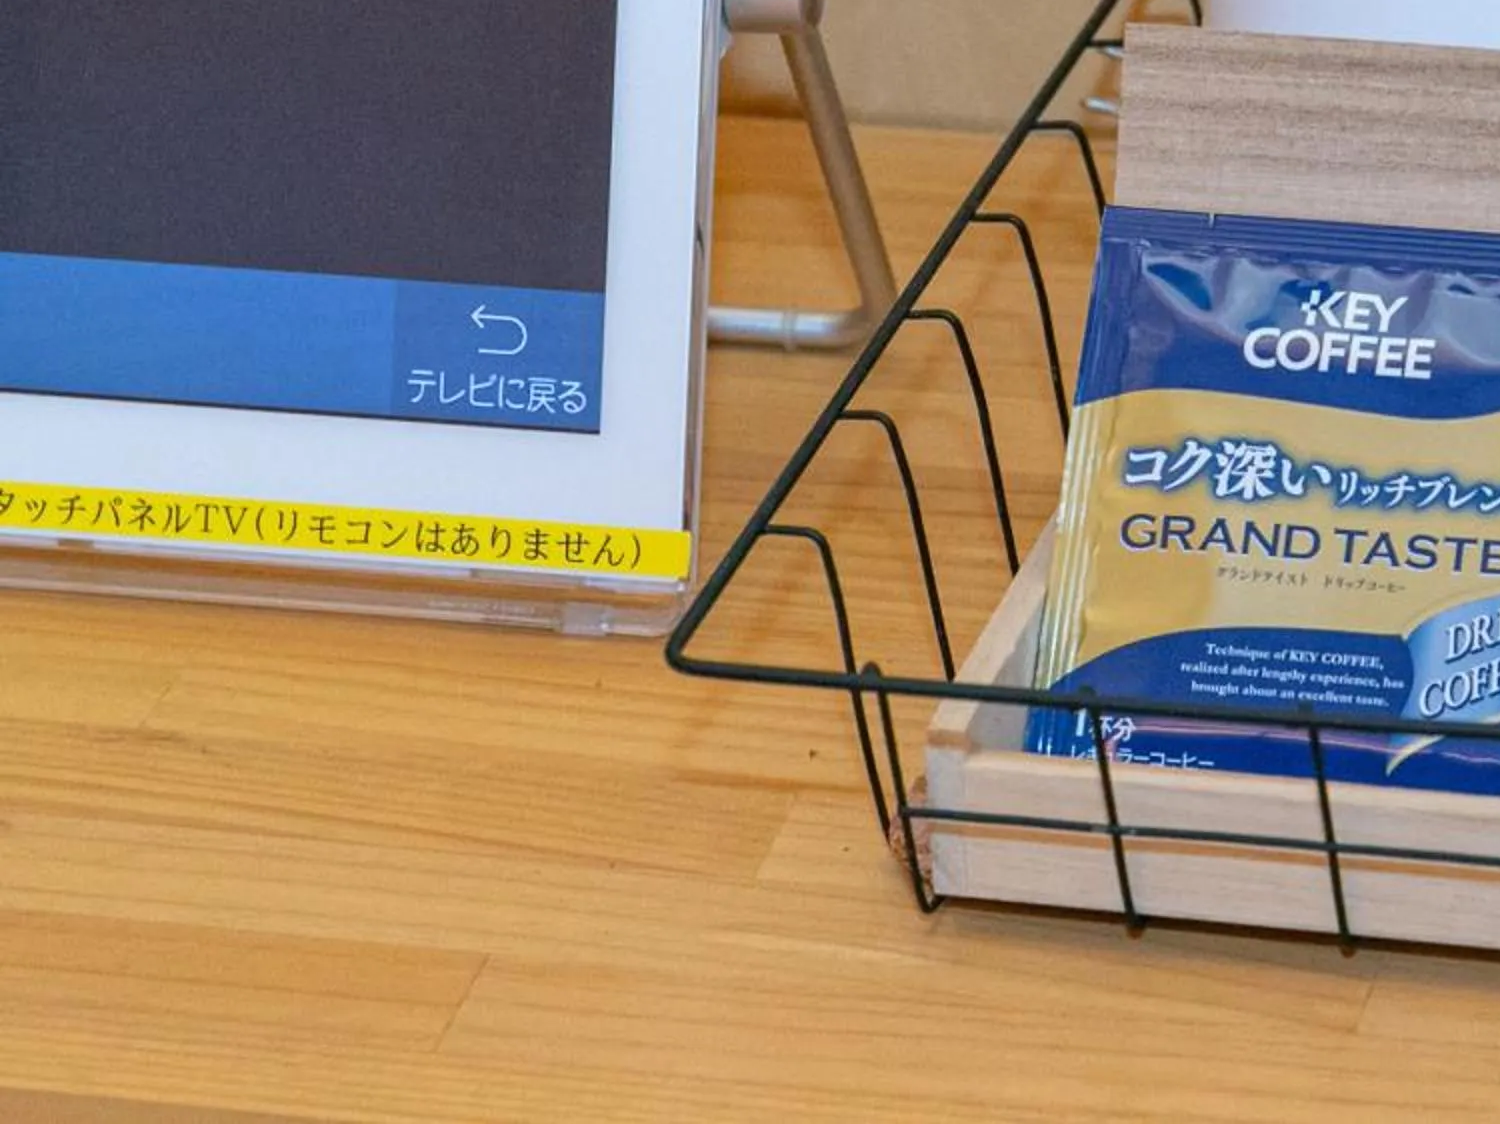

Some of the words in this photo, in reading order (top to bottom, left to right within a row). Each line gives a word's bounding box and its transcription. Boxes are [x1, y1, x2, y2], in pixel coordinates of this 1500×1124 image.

[1301, 289, 1408, 333] KEY
[1243, 327, 1436, 380] COFFEE
[408, 369, 587, 414] テレビに戻る
[1120, 513, 1322, 560] GRAND
[1180, 661, 1228, 676] realized
[1231, 664, 1259, 678] after
[1383, 677, 1404, 689] has
[1206, 643, 1270, 661] Technique
[1273, 649, 1288, 661] of
[1289, 650, 1318, 664] KEY
[1321, 652, 1384, 670] COFFEE,
[1191, 680, 1239, 697] brought
[1242, 684, 1277, 698] about
[1280, 690, 1295, 699] an
[1298, 690, 1353, 704] excellent
